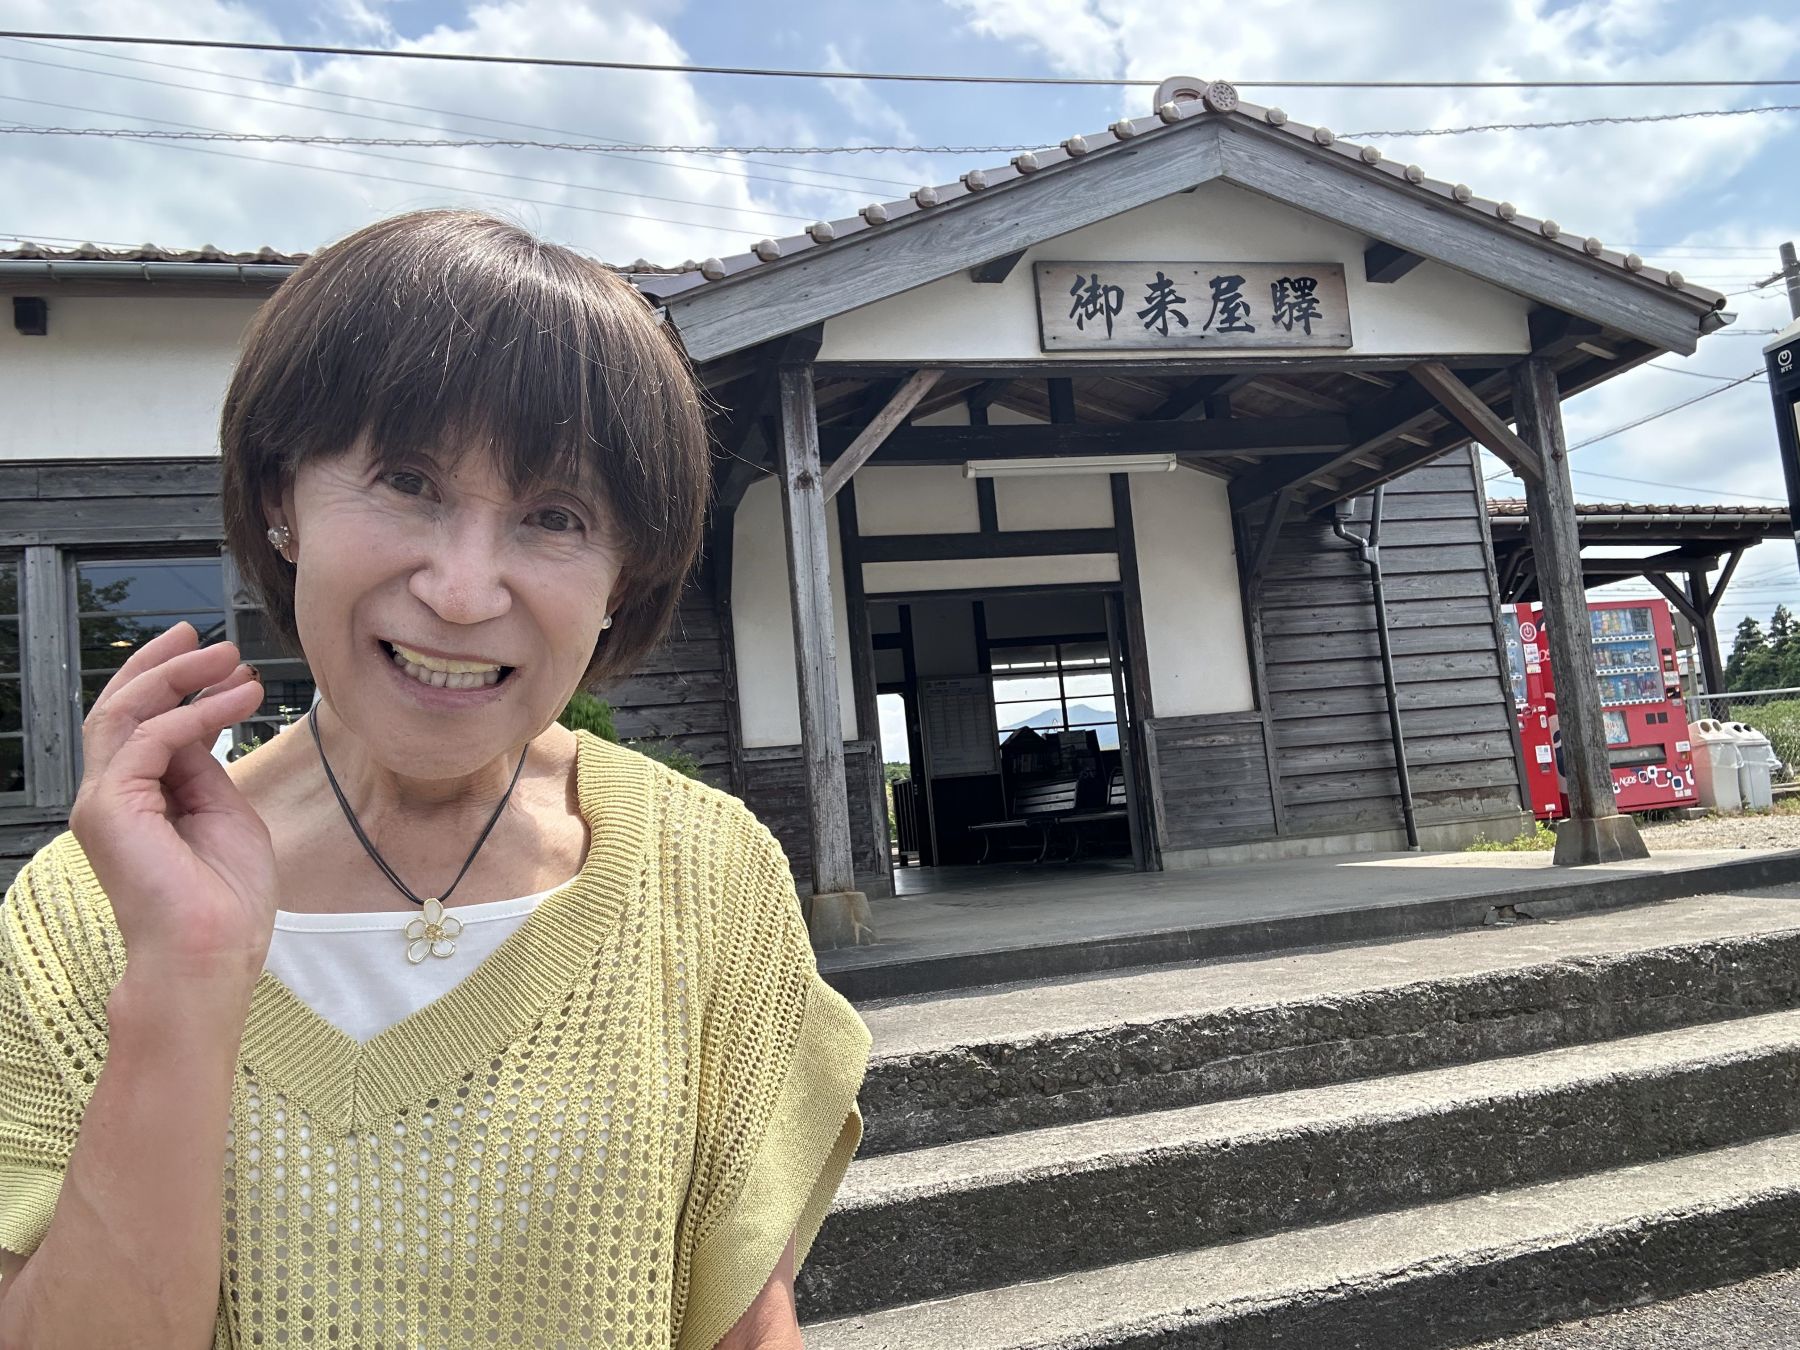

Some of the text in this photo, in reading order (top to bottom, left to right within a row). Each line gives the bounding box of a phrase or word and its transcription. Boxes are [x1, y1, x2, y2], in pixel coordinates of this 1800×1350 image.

[1068, 271, 1323, 340] 御来屋驛
[1780, 363, 1793, 373] NTT
